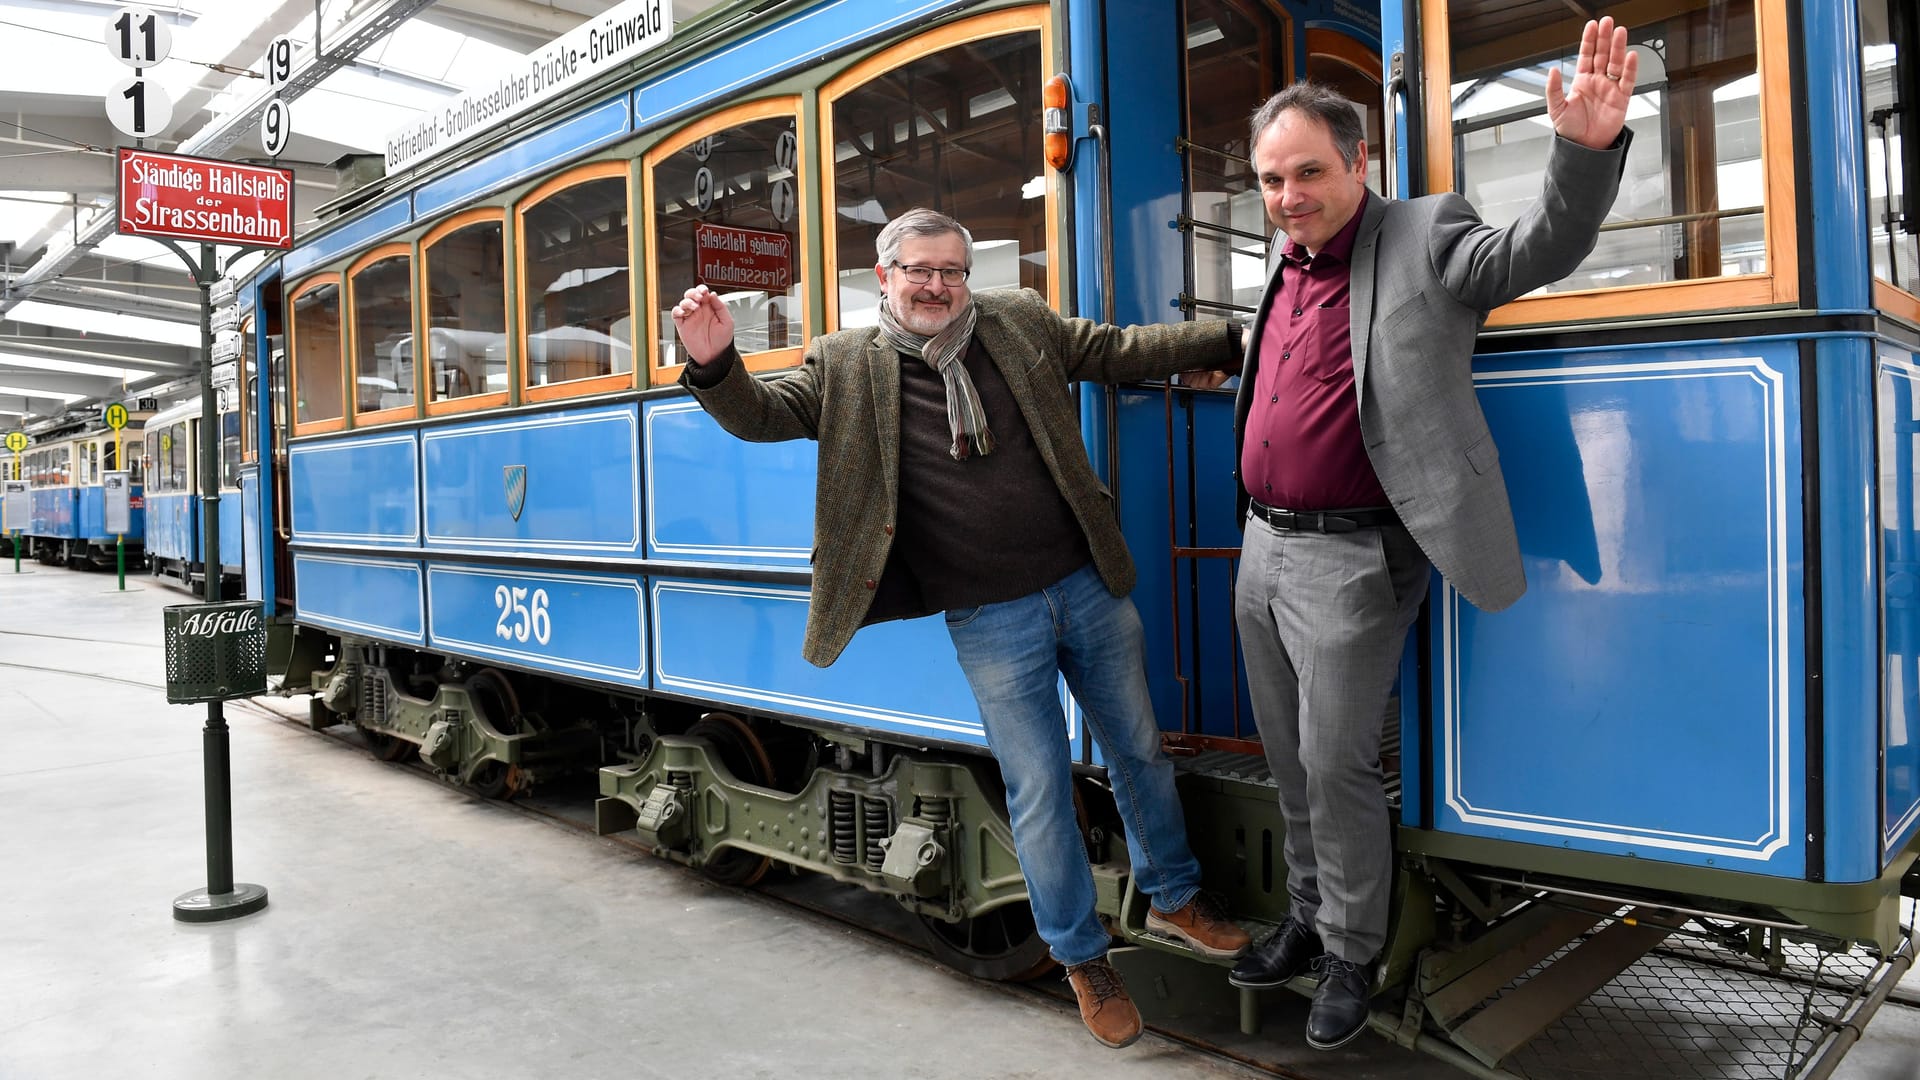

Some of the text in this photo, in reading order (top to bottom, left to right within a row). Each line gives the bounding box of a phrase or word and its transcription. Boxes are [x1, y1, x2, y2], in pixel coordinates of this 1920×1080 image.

[115, 12, 156, 62] 11
[267, 39, 290, 85] 19
[387, 117, 437, 168] Ostfriedhof
[446, 73, 530, 138] Großhesseloher
[532, 47, 578, 95] Brücke
[589, 0, 661, 64] Grünwald
[123, 81, 146, 133] 1
[266, 103, 280, 151] 9
[132, 159, 285, 201] Ständige Haltstelle
[135, 198, 281, 238] Strassenbahn
[196, 196, 222, 207] der
[111, 409, 122, 424] H
[141, 400, 156, 410] 30
[11, 435, 22, 448] H
[179, 609, 257, 638] Abfälle
[495, 585, 551, 646] 256
